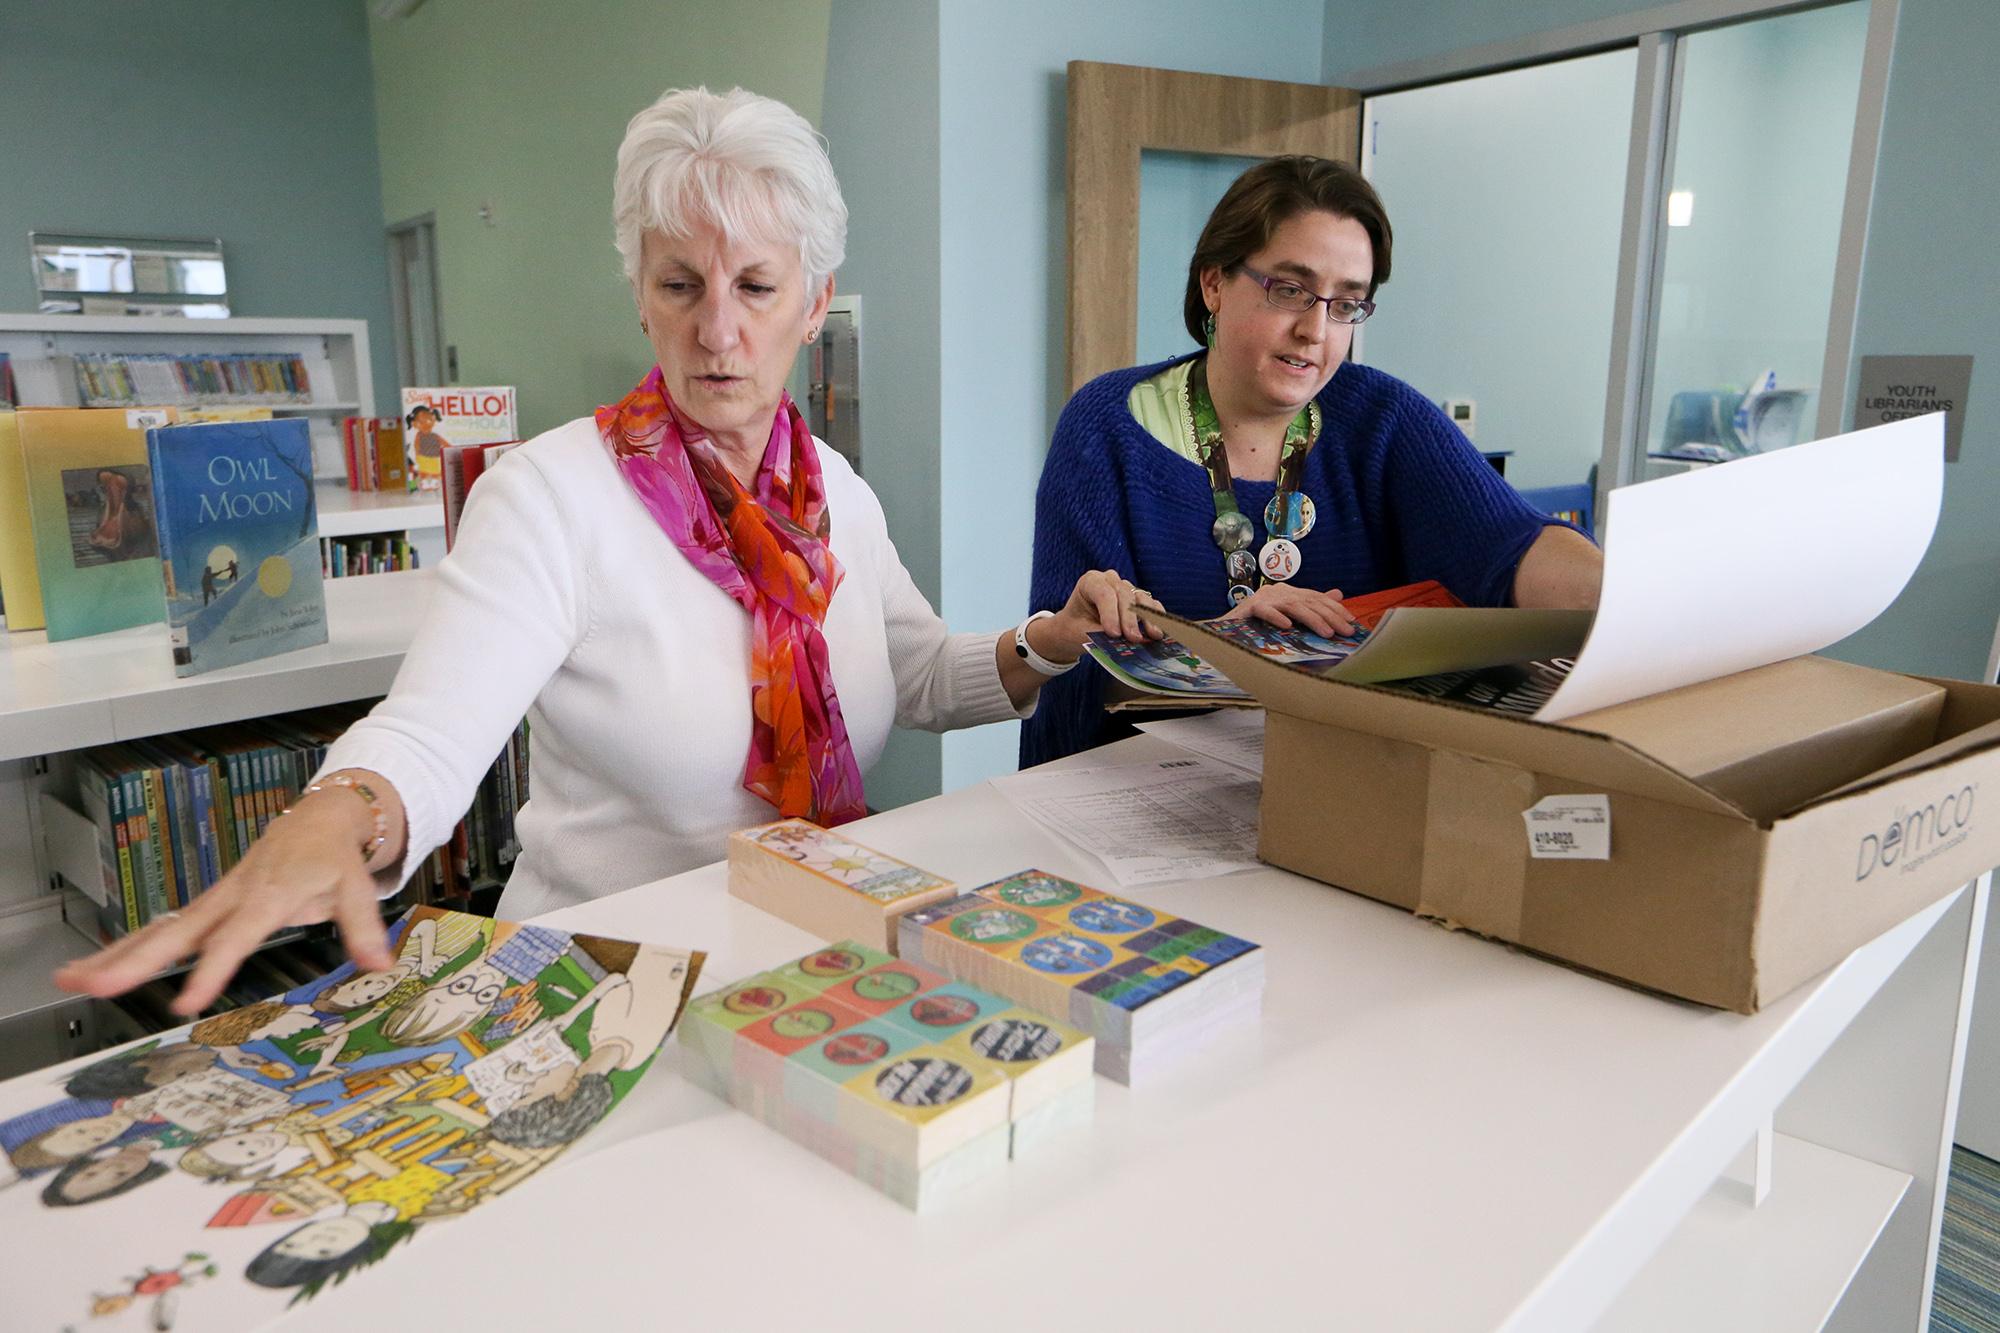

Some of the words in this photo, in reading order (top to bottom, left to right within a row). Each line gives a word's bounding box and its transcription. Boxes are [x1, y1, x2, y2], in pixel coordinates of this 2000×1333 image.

[1888, 386, 1936, 397] YOUTH
[430, 395, 508, 416] HELLO!
[1865, 398, 1953, 411] LIBRARIAN'S
[208, 455, 278, 486] OWL
[198, 489, 293, 524] MOON
[146, 787, 155, 811] Willems
